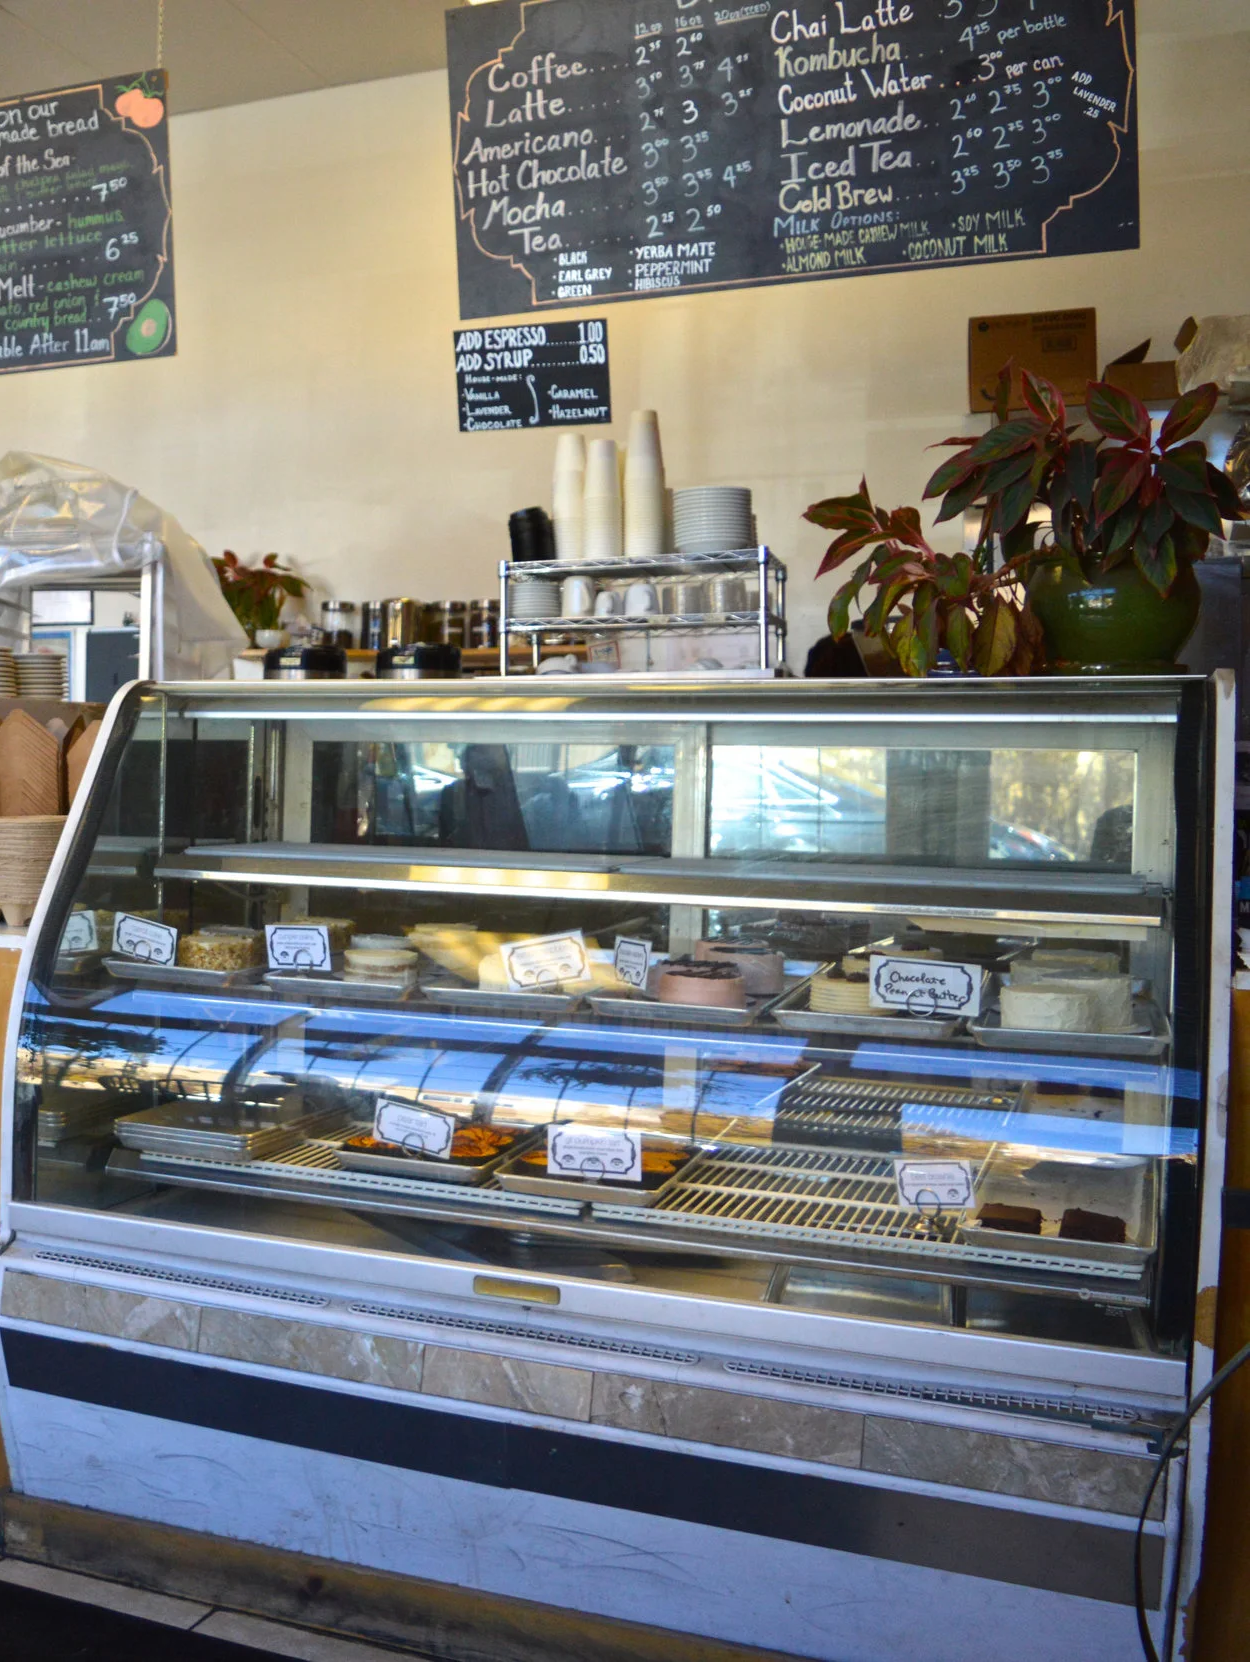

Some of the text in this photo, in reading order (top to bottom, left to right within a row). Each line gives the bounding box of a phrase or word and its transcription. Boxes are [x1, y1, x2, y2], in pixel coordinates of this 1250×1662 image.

[770, 10, 827, 44] Chai
[835, 0, 914, 35] Latte
[774, 33, 900, 78] Kombucha
[997, 26, 1021, 44] per
[1023, 13, 1067, 34] bottle
[488, 52, 587, 92] Coffee
[777, 81, 857, 115] Coconut
[861, 64, 932, 98] Water
[1005, 60, 1028, 79] per
[1033, 55, 1064, 71] can
[1071, 71, 1092, 86] ADD
[28, 101, 59, 120] our
[485, 89, 565, 128] Latte
[1073, 86, 1117, 113] LAVENDER
[47, 110, 99, 136] bread
[462, 128, 593, 166] Americano
[682, 100, 698, 124] 3
[781, 99, 922, 149] Lemonade
[16, 153, 39, 174] the
[468, 164, 510, 199] Hot
[516, 145, 628, 190] Chocolate
[780, 144, 856, 185] Iced
[860, 140, 912, 173] Tea
[779, 183, 831, 214] Cold
[835, 180, 893, 211] Brew
[68, 209, 124, 229] hummus
[483, 192, 565, 231] Mocha
[958, 208, 1026, 232] SOY MILK
[45, 230, 102, 249] lettuce
[773, 215, 820, 238] MILK
[858, 225, 899, 245] CASHEW
[900, 220, 930, 238] MILK
[508, 226, 562, 255] Tea
[635, 241, 716, 260] YERBA MATE
[908, 232, 1008, 261] COCONUT MILK
[558, 251, 588, 266] BLACK
[635, 258, 713, 278] PEPPERMINT
[785, 246, 867, 273] ALMOND MILK
[47, 273, 98, 292] cashew
[103, 269, 144, 287] cream
[558, 267, 613, 283] EARL GREY
[634, 276, 681, 291] HIBISCUS
[28, 295, 49, 313] red
[557, 284, 593, 299] GREEN
[29, 332, 70, 355] After
[74, 328, 110, 352] 11am
[455, 321, 603, 352] ADD ESPRESSO 1.00
[456, 343, 606, 373] ADD SYRUP 0.50
[890, 971, 946, 986] Chocolate
[928, 988, 966, 1002] Butter
